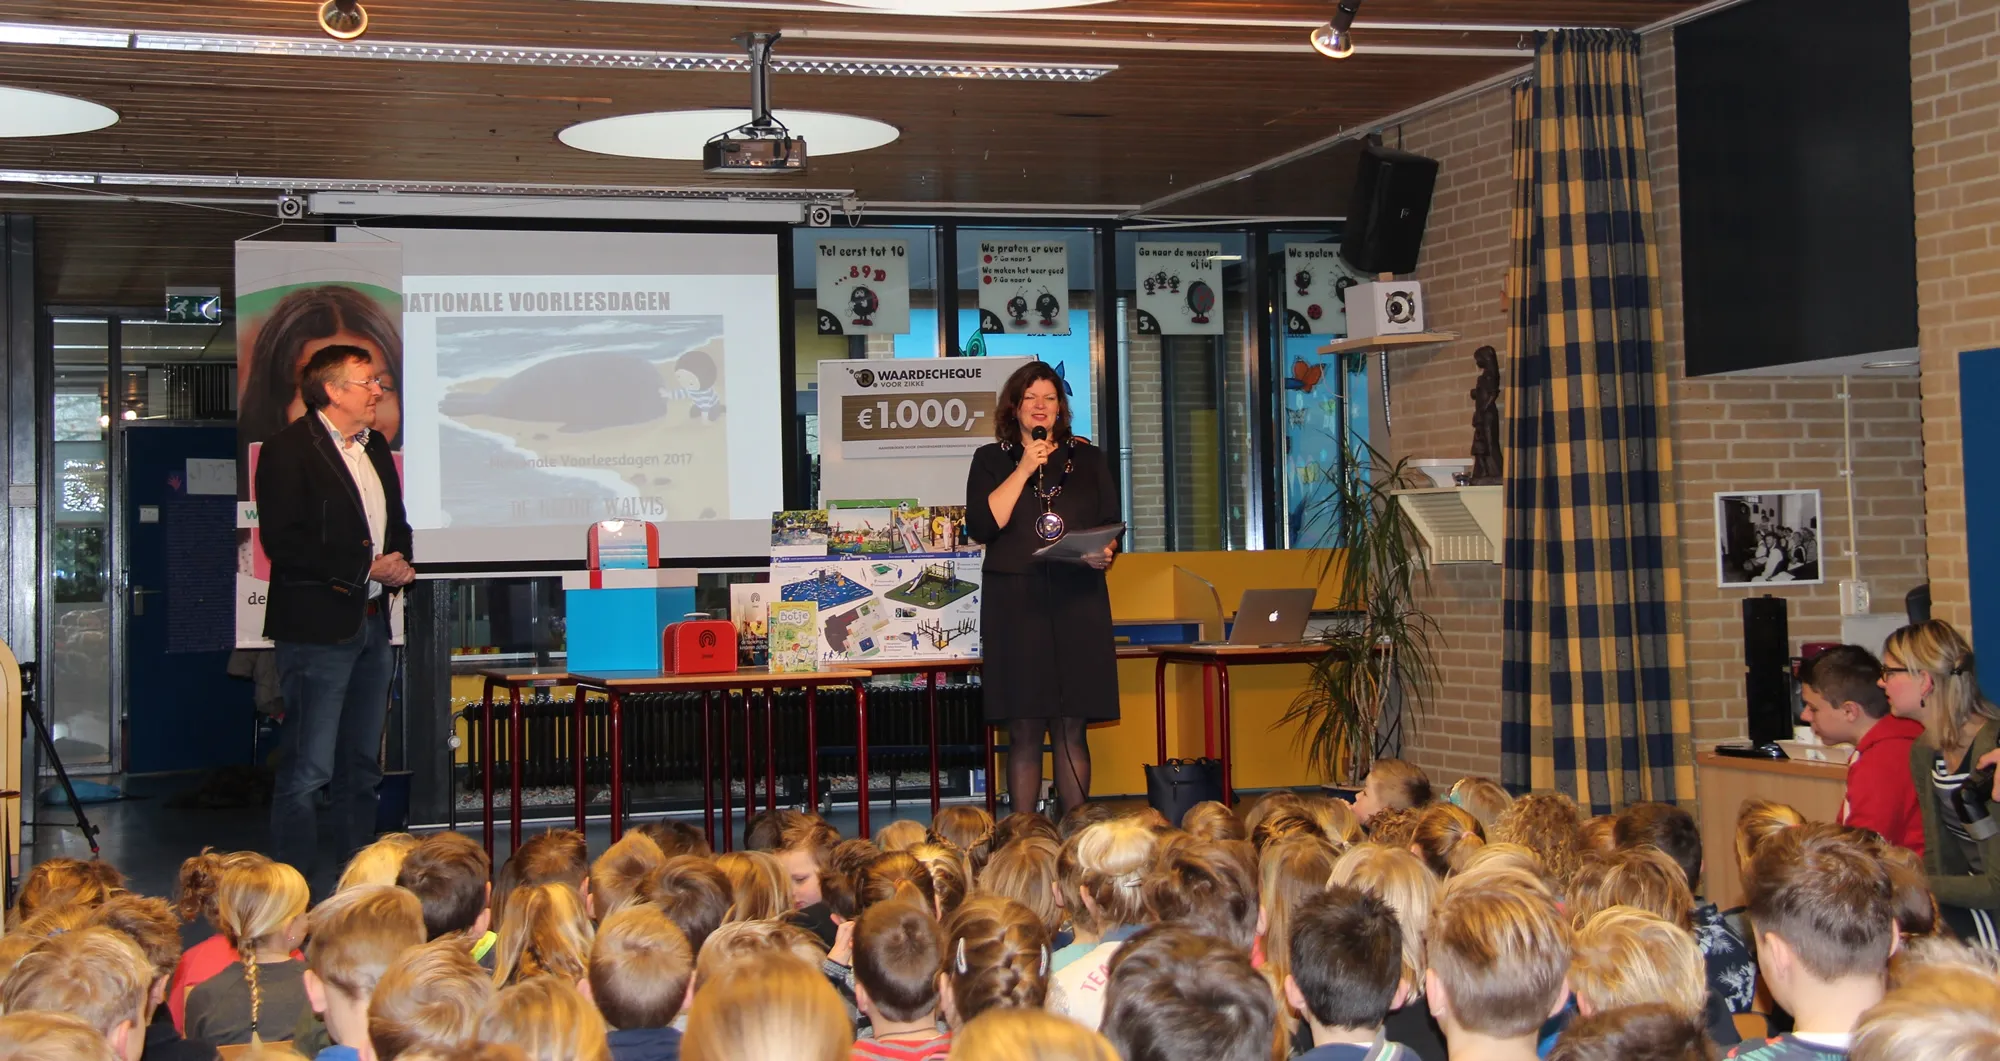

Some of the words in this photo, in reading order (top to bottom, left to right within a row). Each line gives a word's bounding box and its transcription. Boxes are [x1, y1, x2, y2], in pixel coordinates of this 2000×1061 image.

[819, 245, 836, 257] Tel
[840, 247, 867, 257] eerst
[871, 247, 887, 257] tot
[891, 246, 905, 257] 10
[982, 243, 995, 253] We
[998, 244, 1029, 254] praten
[1139, 248, 1150, 256] Ga
[1174, 248, 1184, 256] de
[1289, 248, 1302, 258] We
[1305, 248, 1334, 260] spelen
[1048, 267, 1065, 276] goed
[508, 291, 671, 312] VOORLEESDAGEN
[877, 368, 982, 381] WAARDECHEQUE
[490, 456, 557, 469] Nnale
[560, 454, 660, 468] Voorleesdagen
[663, 453, 694, 465] 2017
[780, 611, 809, 624] Botje
